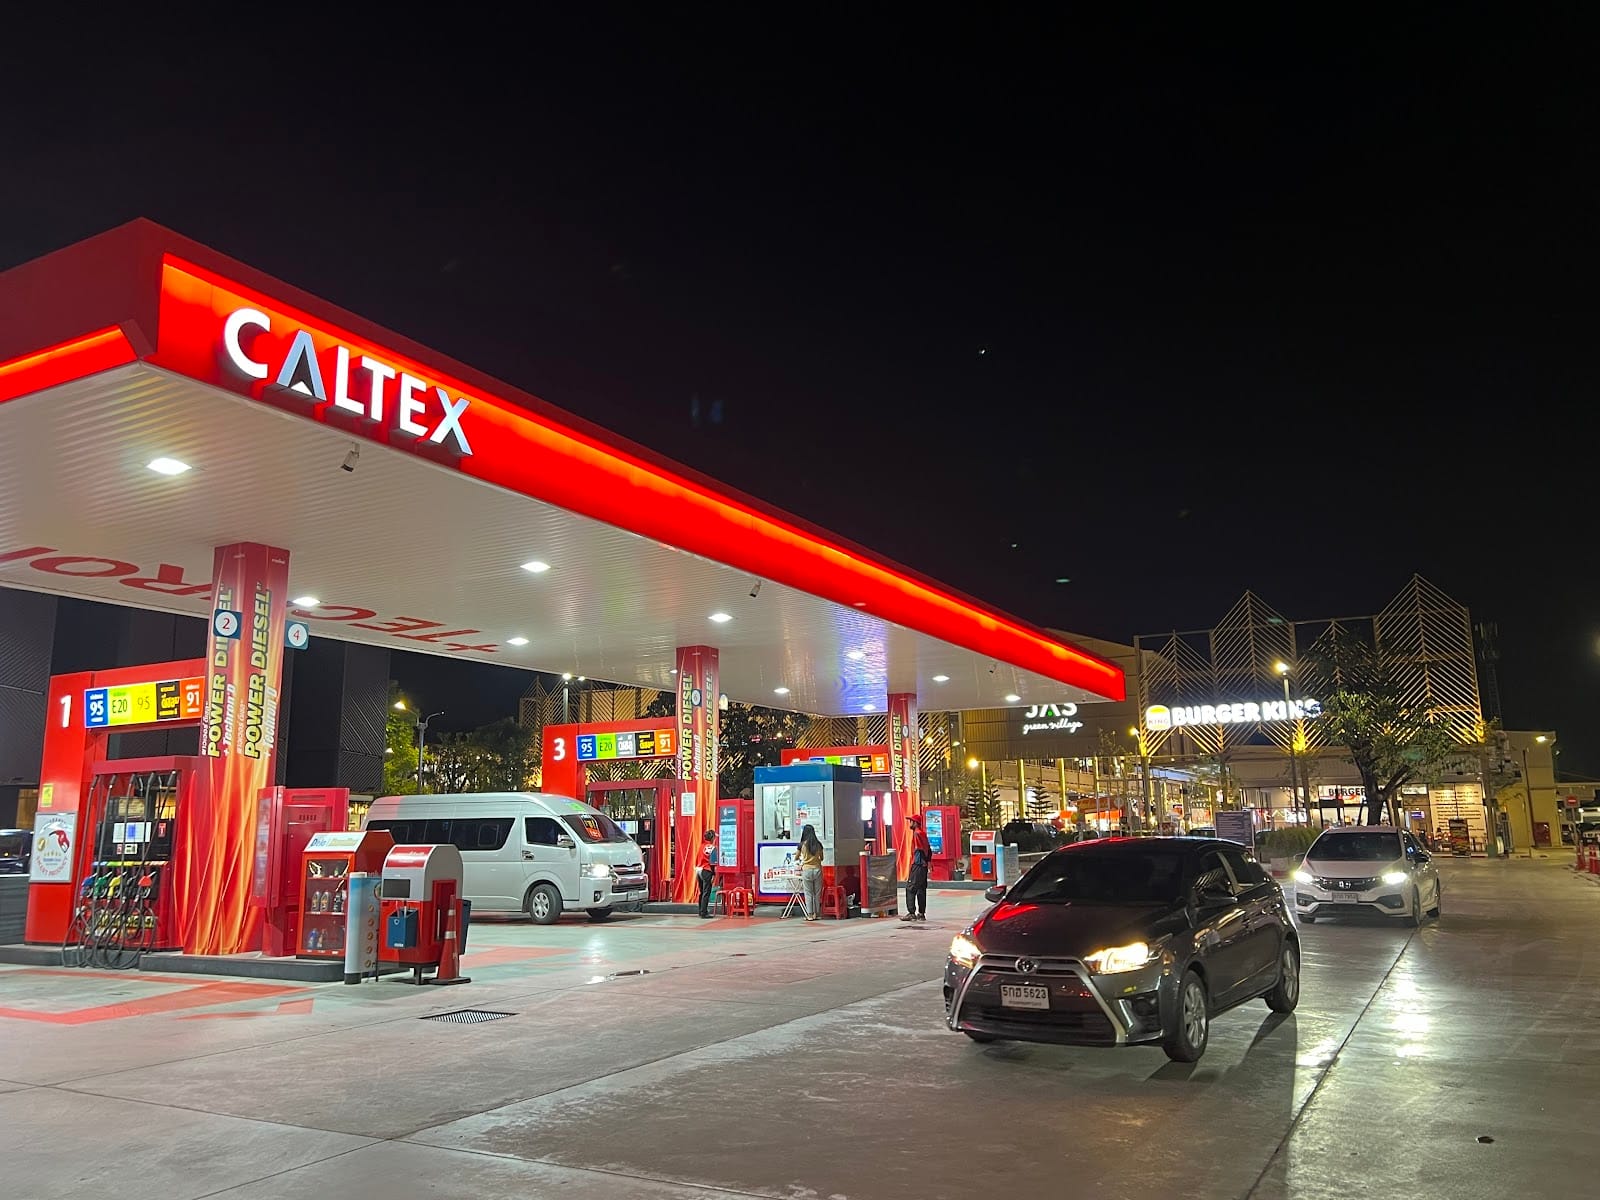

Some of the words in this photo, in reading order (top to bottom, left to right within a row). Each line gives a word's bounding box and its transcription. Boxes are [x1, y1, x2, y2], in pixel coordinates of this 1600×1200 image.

[224, 307, 474, 457] CALTEX
[214, 589, 232, 667] DIEL
[222, 617, 230, 630] 2
[249, 589, 271, 669] DIESEL
[293, 629, 300, 641] 4
[60, 694, 72, 728] 1
[89, 700, 104, 716] 95
[111, 698, 128, 715] E20
[137, 696, 151, 711] 95
[186, 690, 200, 706] 91
[683, 673, 693, 725] DIESEL
[207, 674, 226, 758] POWER
[243, 674, 265, 759] POWER
[1170, 702, 1261, 727] BURGER
[1262, 697, 1323, 723] KING
[599, 740, 613, 752] E20
[660, 738, 671, 749] 91
[893, 714, 902, 751] DIESEL
[553, 737, 566, 761] 3
[581, 742, 593, 753] 95
[682, 728, 693, 781] POWER
[894, 754, 904, 793] POWER
[1023, 987, 1047, 999] 5623
